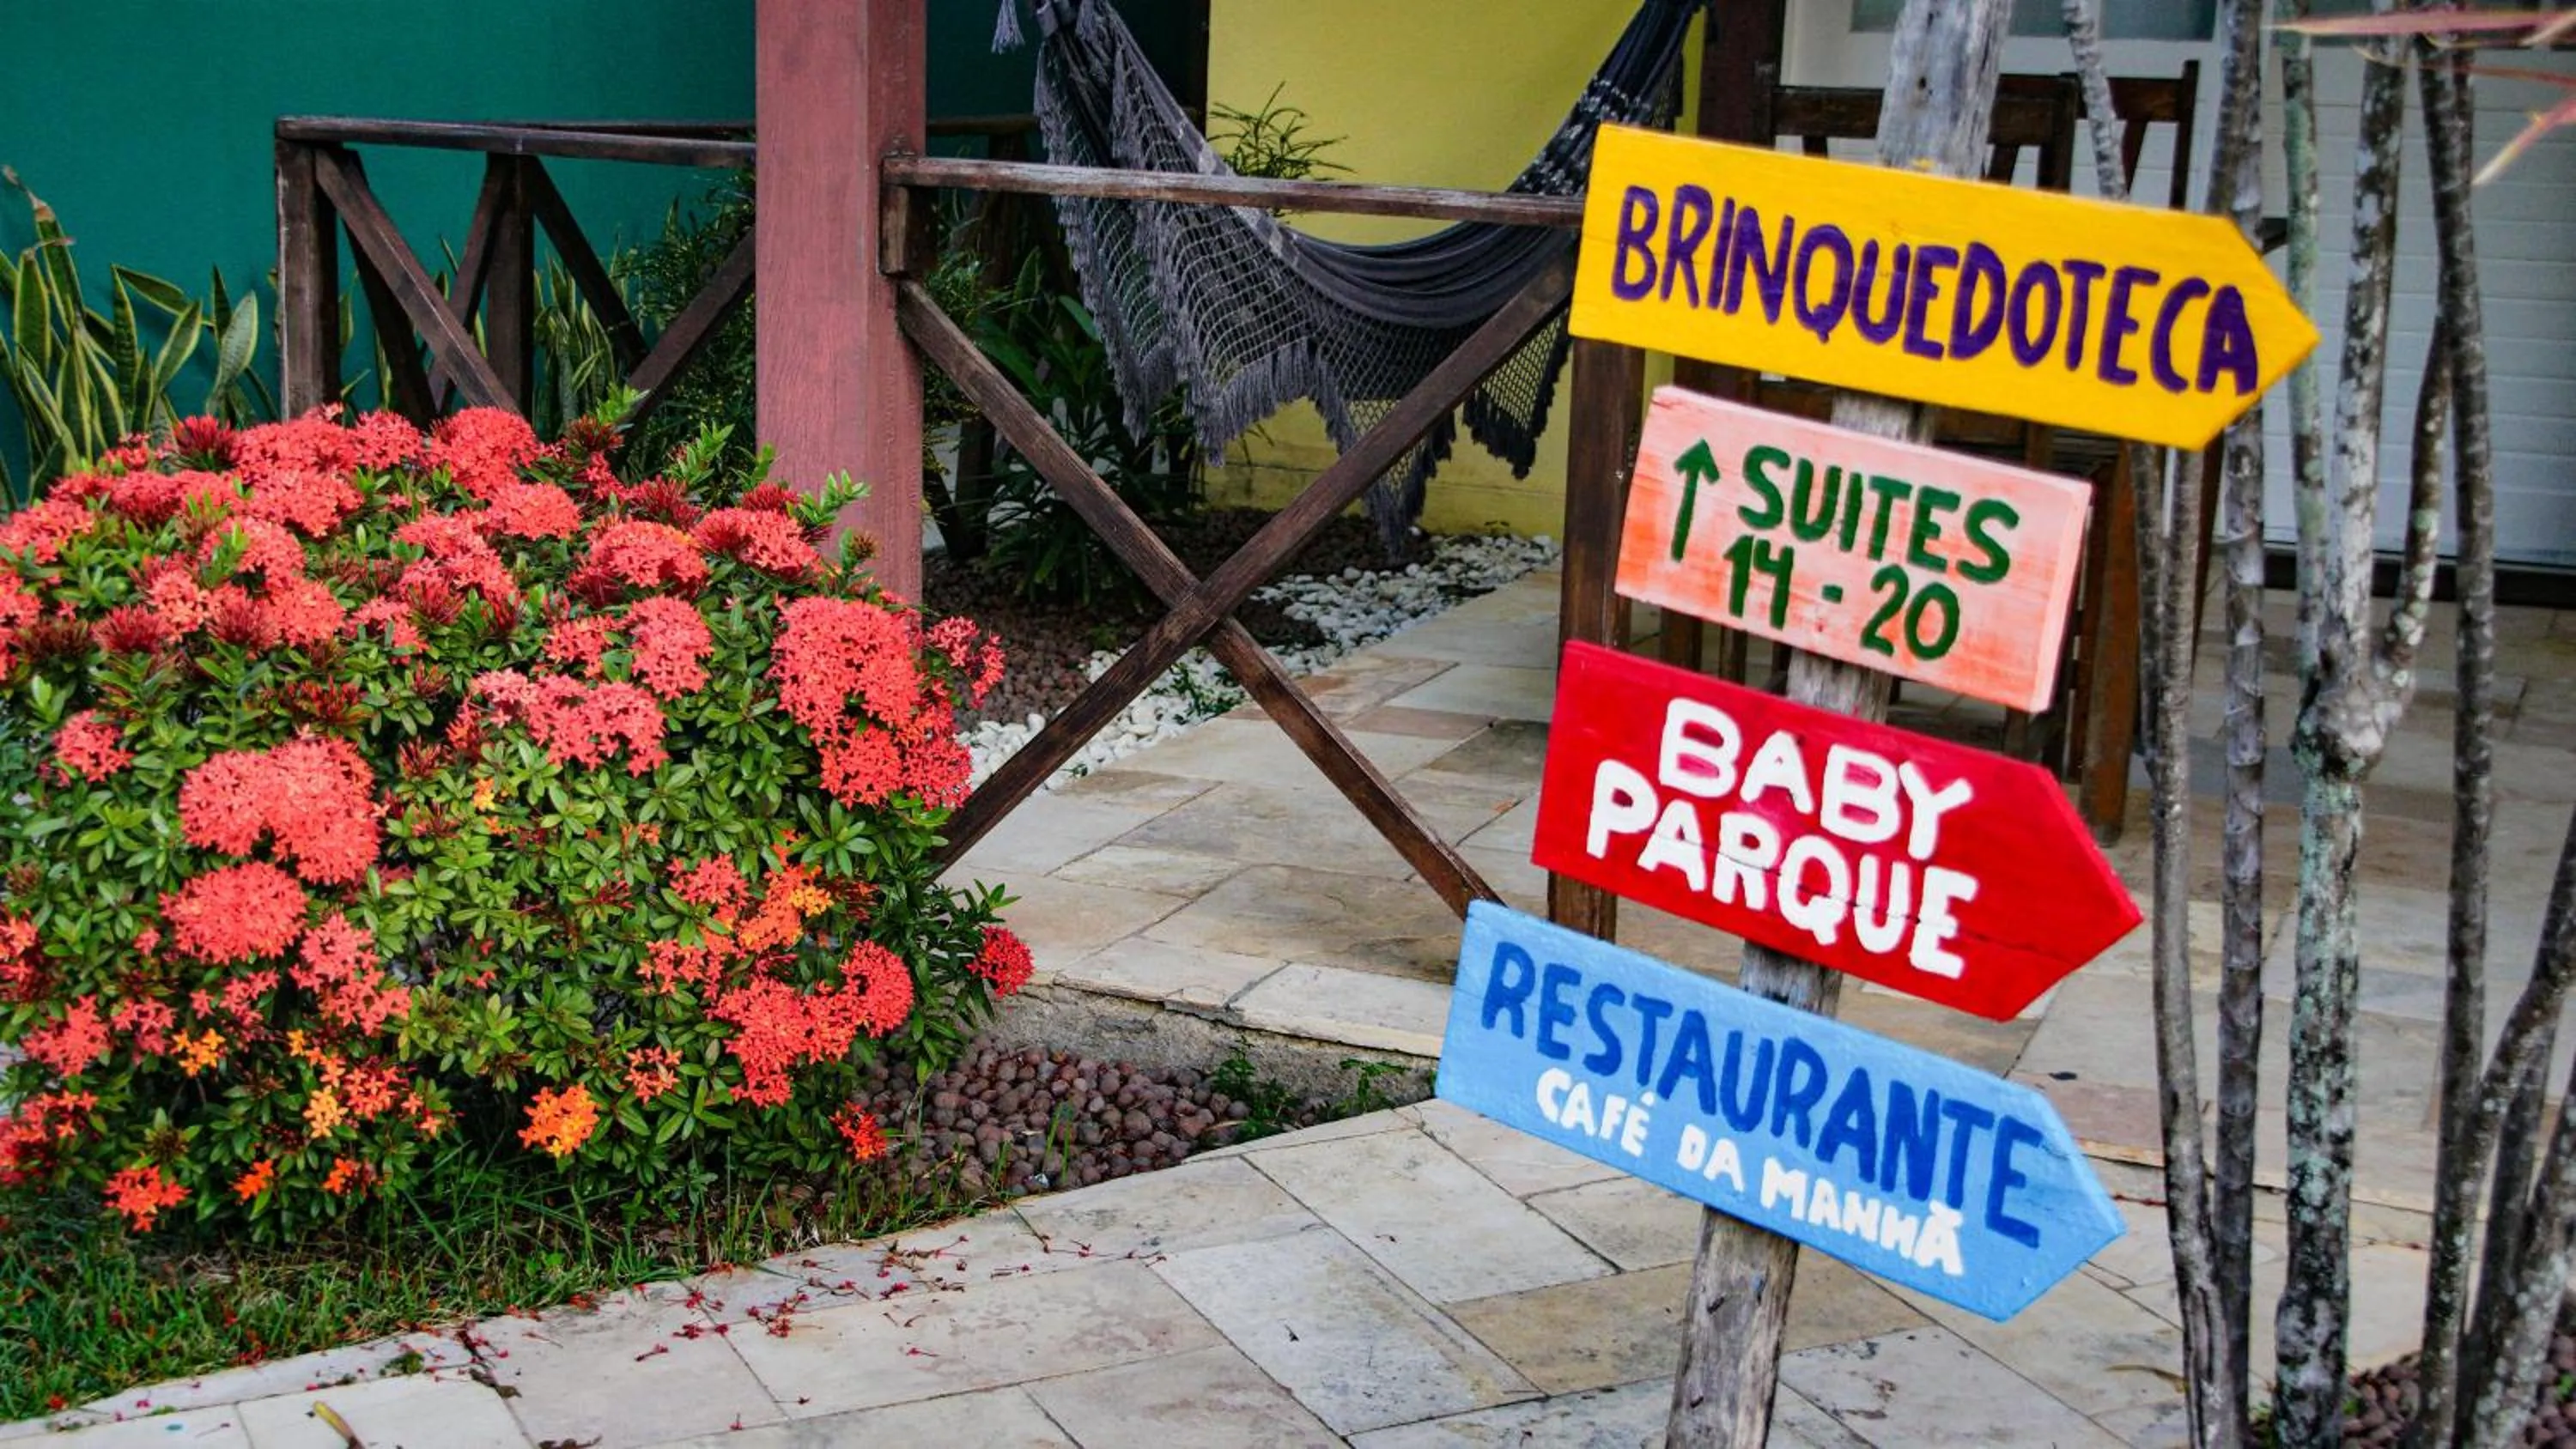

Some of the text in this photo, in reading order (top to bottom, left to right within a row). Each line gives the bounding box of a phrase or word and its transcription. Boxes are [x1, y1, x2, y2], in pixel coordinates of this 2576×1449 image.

[1612, 184, 2259, 397] BRINQUEDOTECA
[1722, 535, 1794, 630] 14
[1860, 563, 1961, 660] 20
[1737, 445, 2020, 584] SUITES
[1586, 759, 1978, 979] PARQUE
[1658, 697, 1973, 860] BABY
[1481, 941, 2044, 1248] RESTAURANTE
[1535, 1067, 1965, 1276] CAFÉ DA MANHÃ
